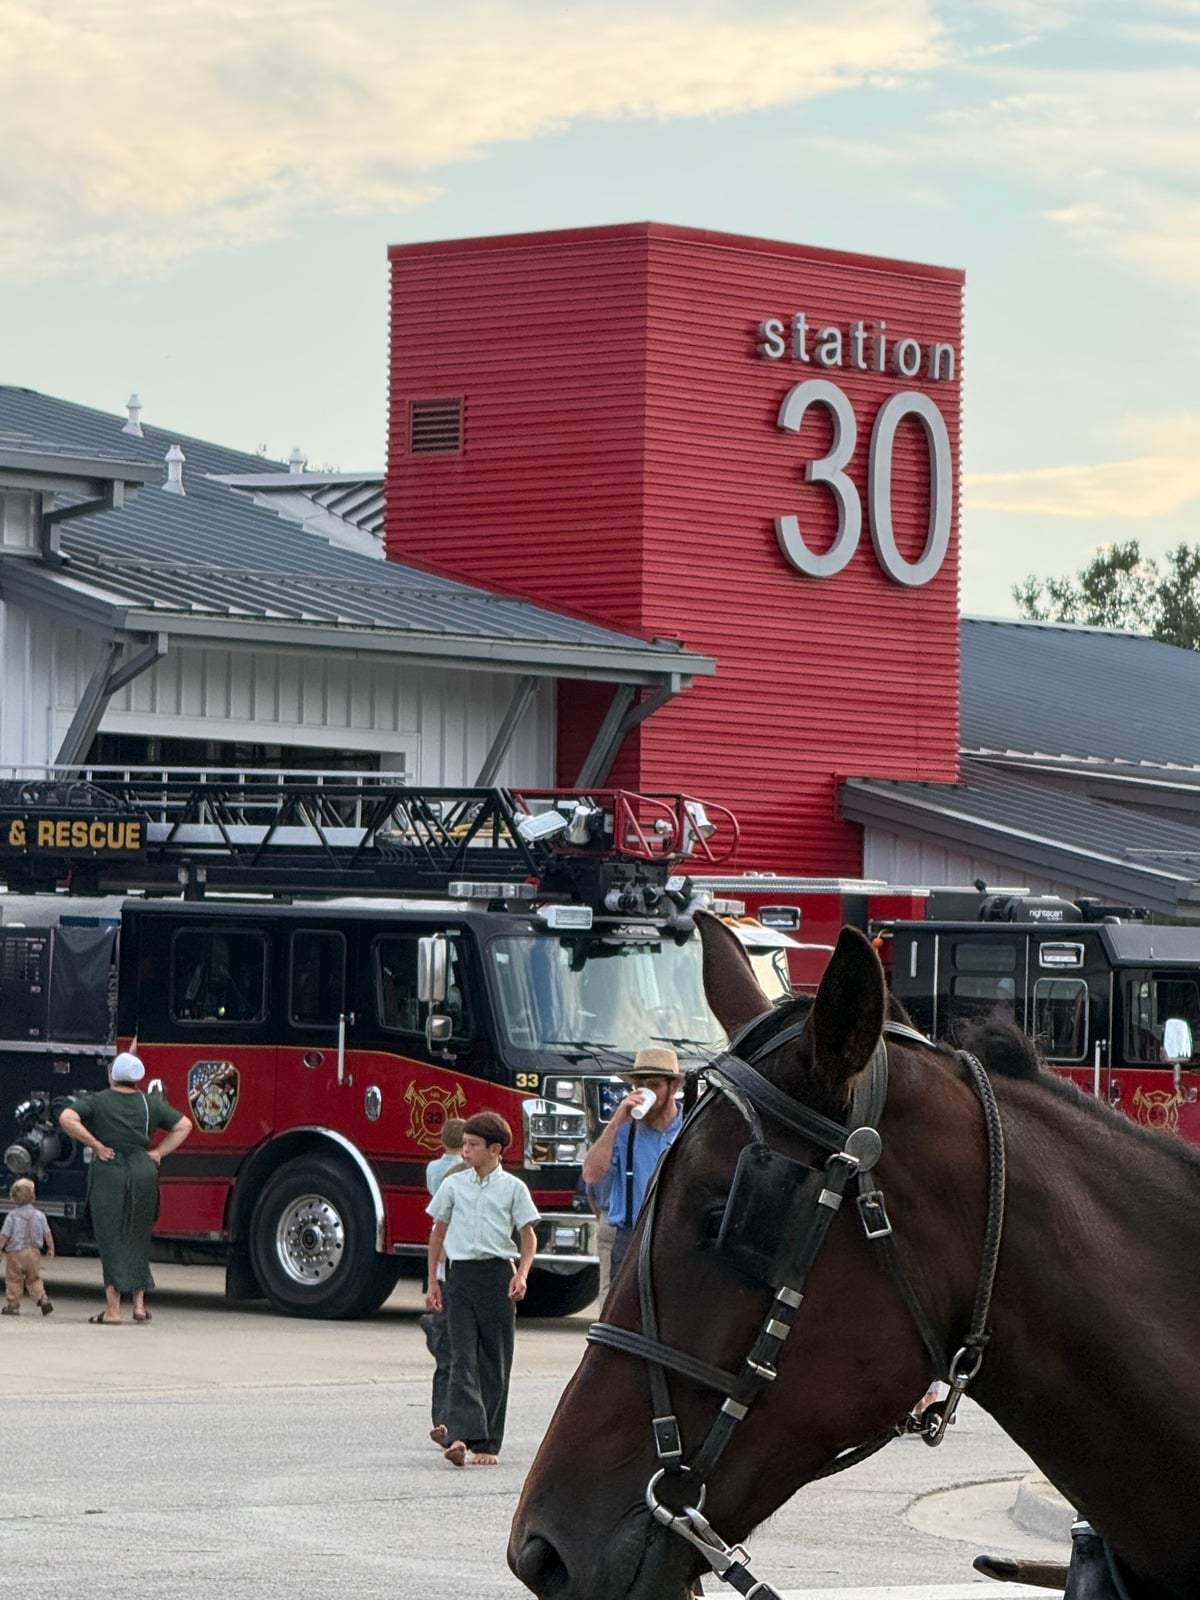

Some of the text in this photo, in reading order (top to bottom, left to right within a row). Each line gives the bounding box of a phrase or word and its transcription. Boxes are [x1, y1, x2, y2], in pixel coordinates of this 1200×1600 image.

[758, 312, 955, 381] station
[774, 378, 953, 587] 30
[9, 819, 141, 849] & RESCUE
[516, 1073, 539, 1088] 33
[426, 1111, 443, 1124] 33
